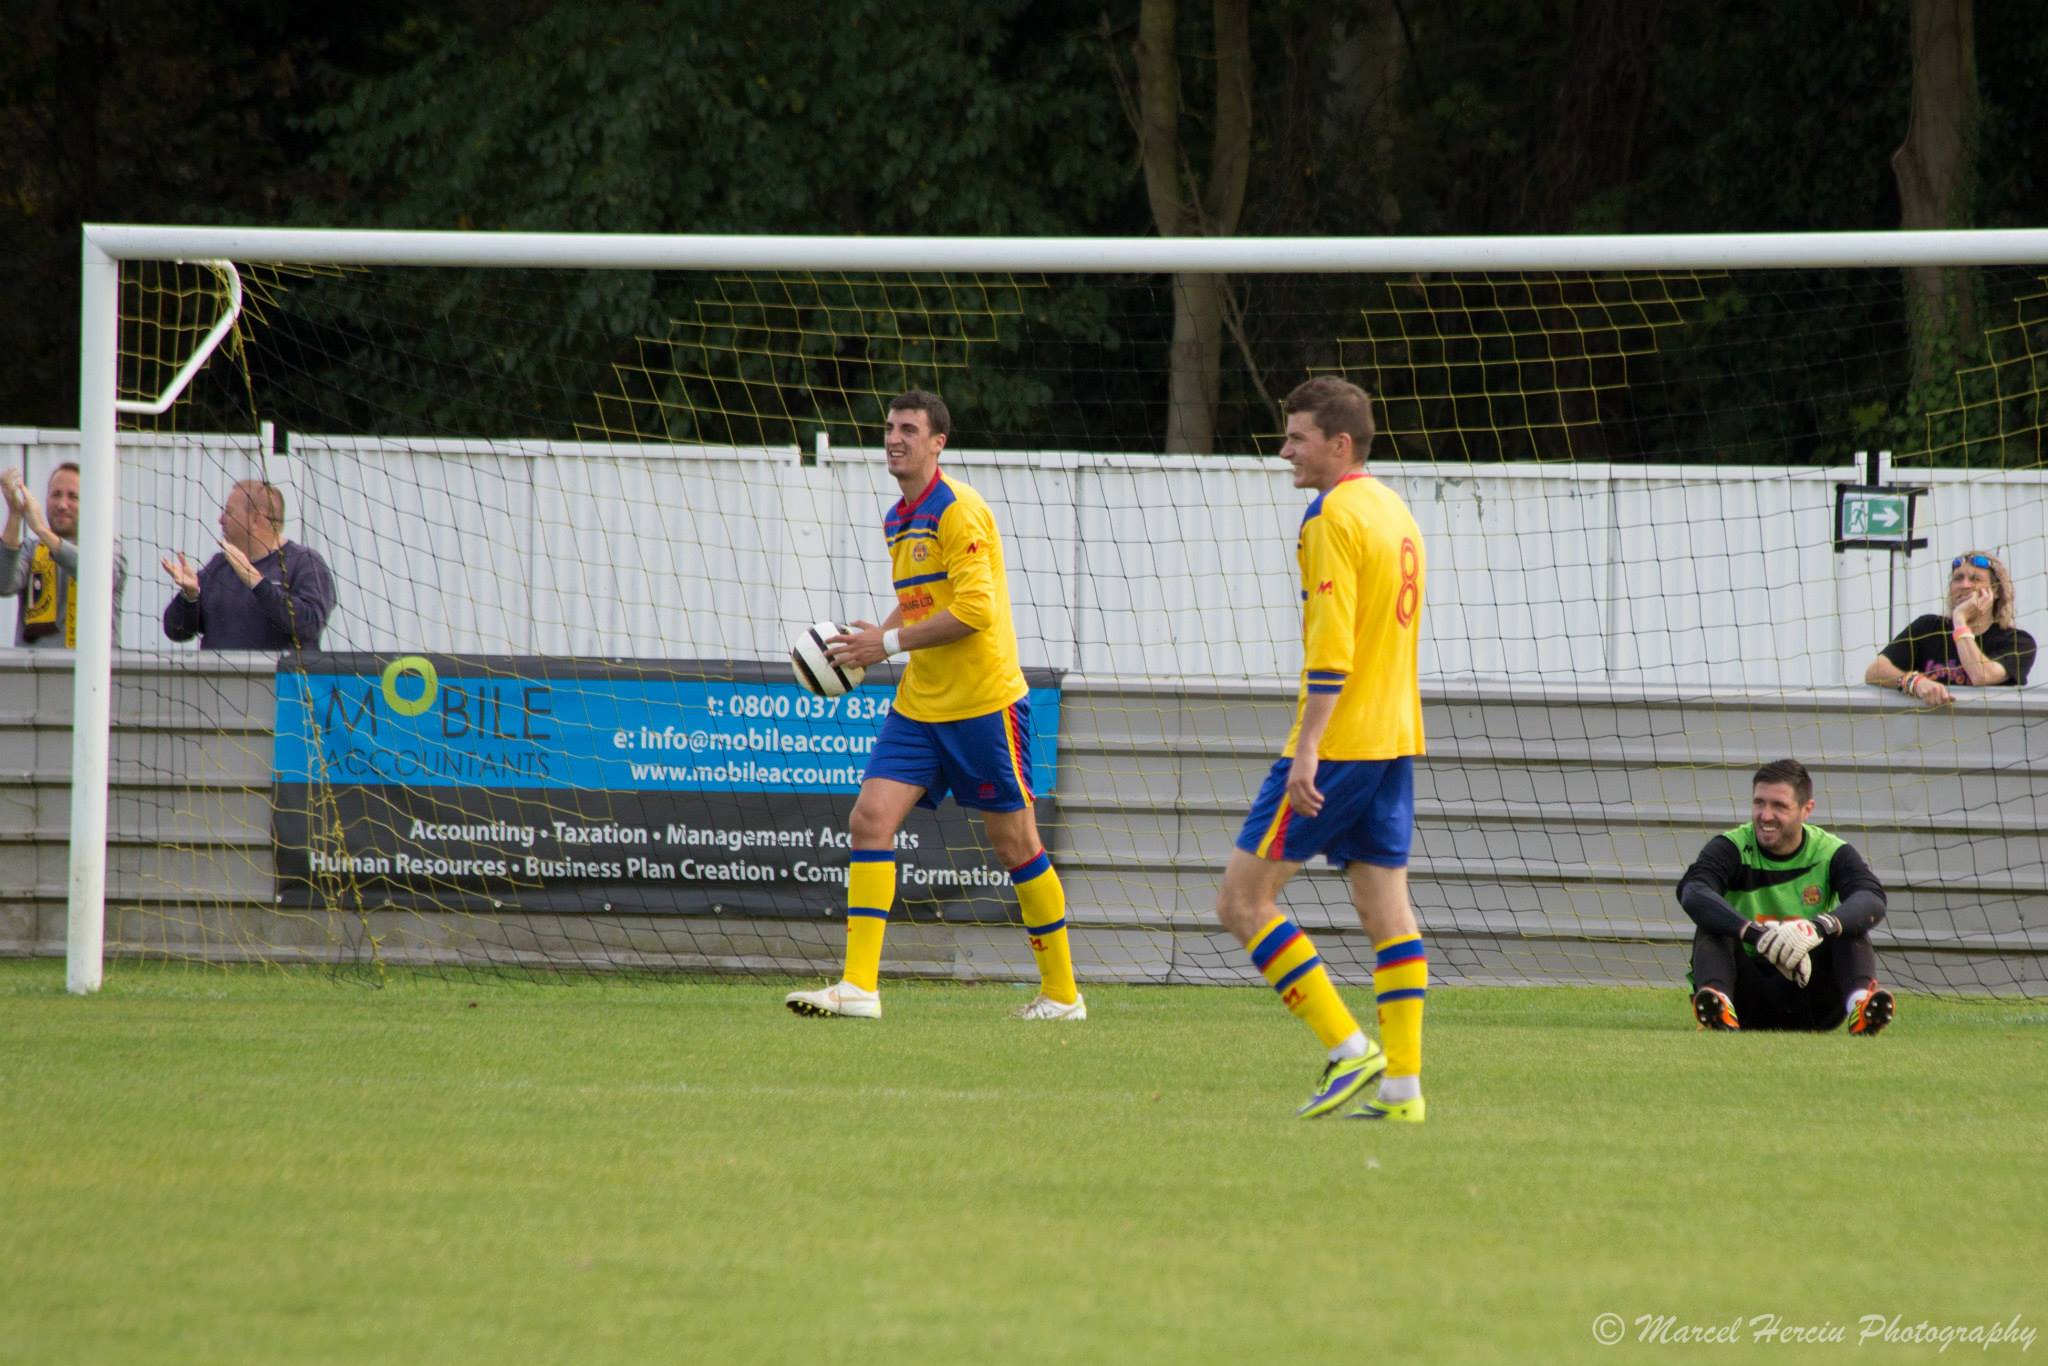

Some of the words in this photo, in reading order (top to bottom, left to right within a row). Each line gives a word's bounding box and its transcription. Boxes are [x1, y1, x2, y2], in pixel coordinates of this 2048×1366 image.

[1396, 537, 1419, 629] 8
[325, 656, 551, 740] MOBILE
[707, 696, 724, 717] t:
[730, 695, 790, 718] 0800
[795, 695, 840, 719] 037
[613, 731, 635, 750] e:
[326, 749, 550, 779] ACCOUNTANTS
[409, 818, 535, 847] Accounting
[553, 821, 647, 846] Taxation
[666, 824, 814, 852] Management
[310, 852, 390, 874] Human
[395, 854, 507, 876] Resources
[526, 857, 622, 879] Business
[627, 858, 676, 880] Plan
[681, 859, 775, 882] Creation
